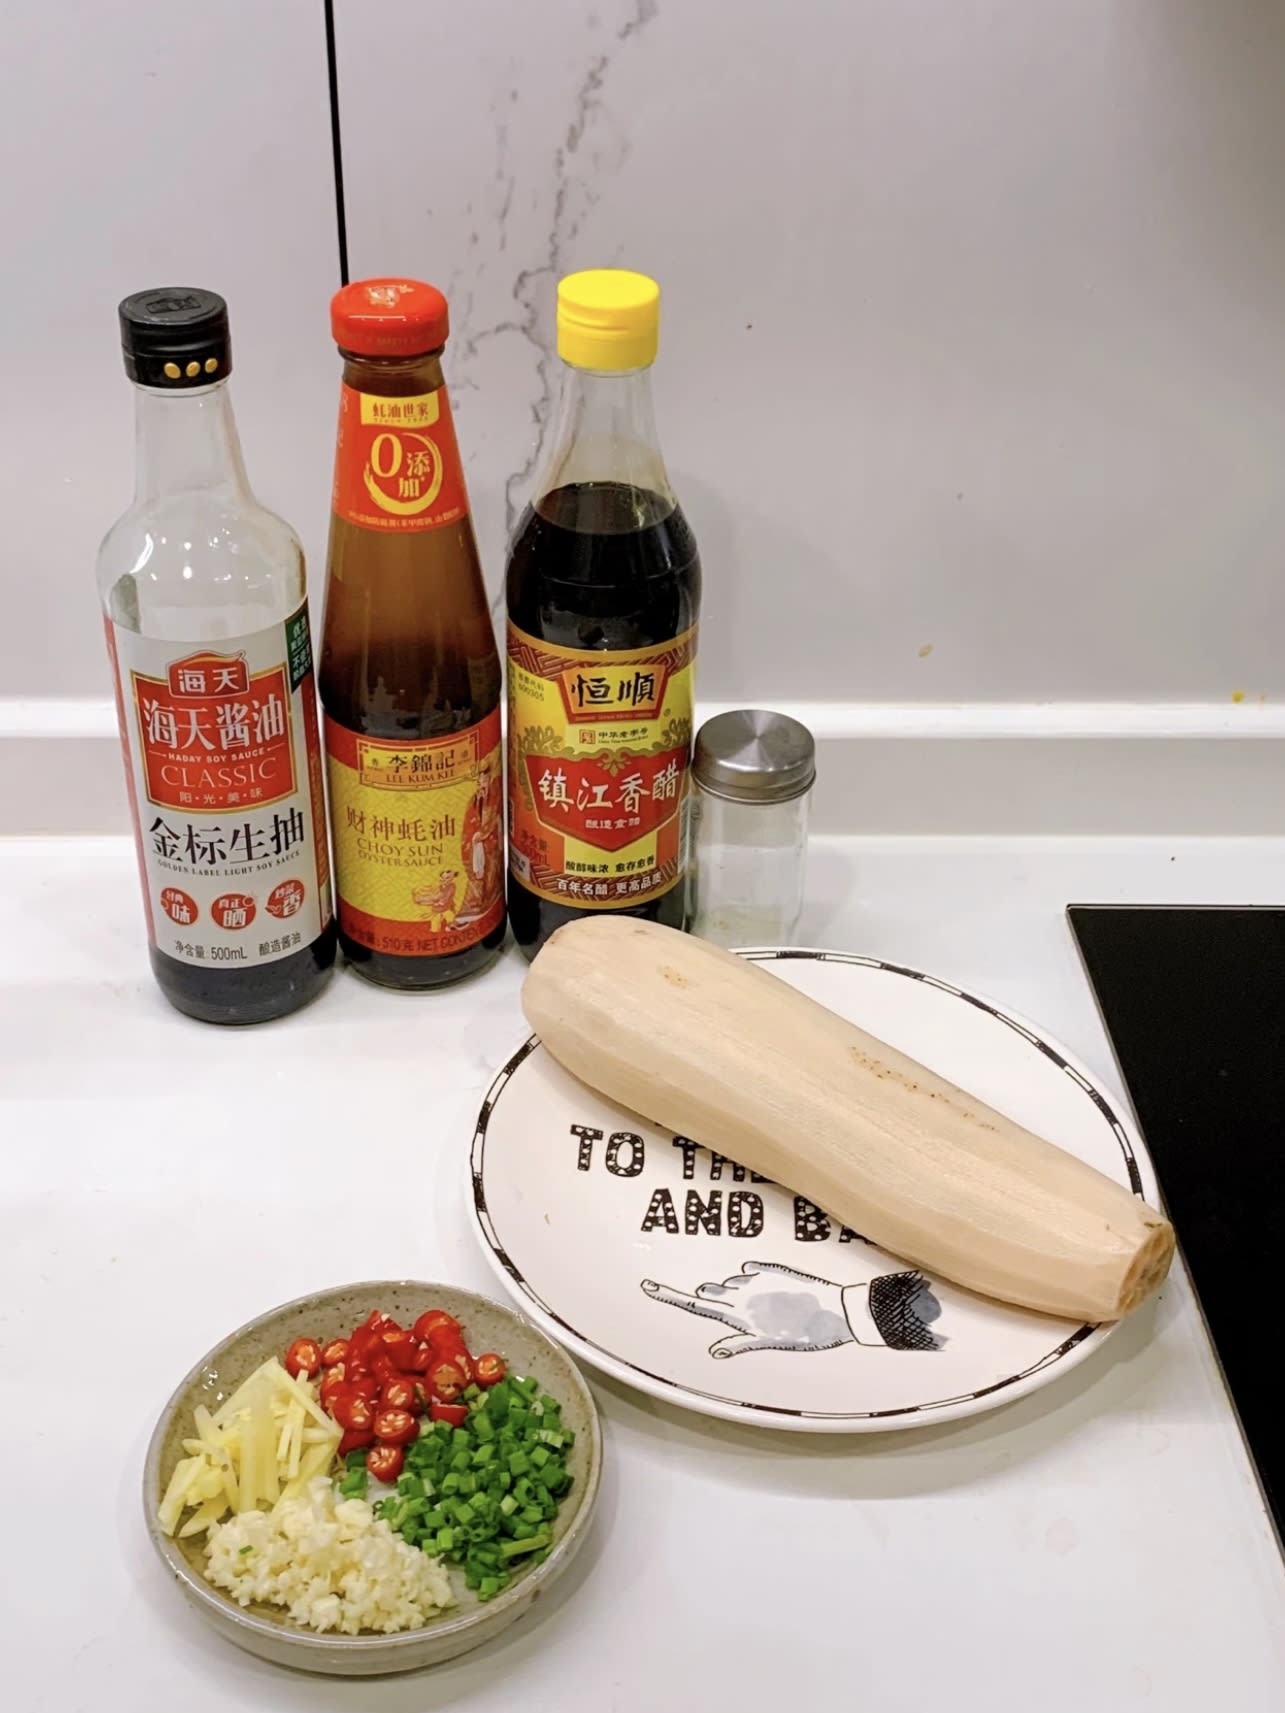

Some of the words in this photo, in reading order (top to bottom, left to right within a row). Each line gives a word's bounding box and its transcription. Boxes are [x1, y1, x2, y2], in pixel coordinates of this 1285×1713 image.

[177, 667, 240, 693] 海天
[143, 693, 285, 750] 海天酱油
[207, 755, 227, 764] SOY
[231, 748, 265, 761] SAUCE
[160, 757, 277, 790] CLASSIC
[408, 774, 434, 783] KUM
[538, 758, 679, 813] 镇江香醋
[150, 807, 304, 866] 金标生抽
[346, 806, 455, 842] 财神蚝油
[357, 837, 404, 856] CHOY
[408, 843, 443, 857] SUN
[192, 868, 220, 877] LABEL
[224, 866, 253, 876] LIGHT
[256, 861, 273, 872] SOY
[211, 946, 248, 960] 500mL
[569, 1123, 646, 1178] TO
[640, 1187, 764, 1238] AND
